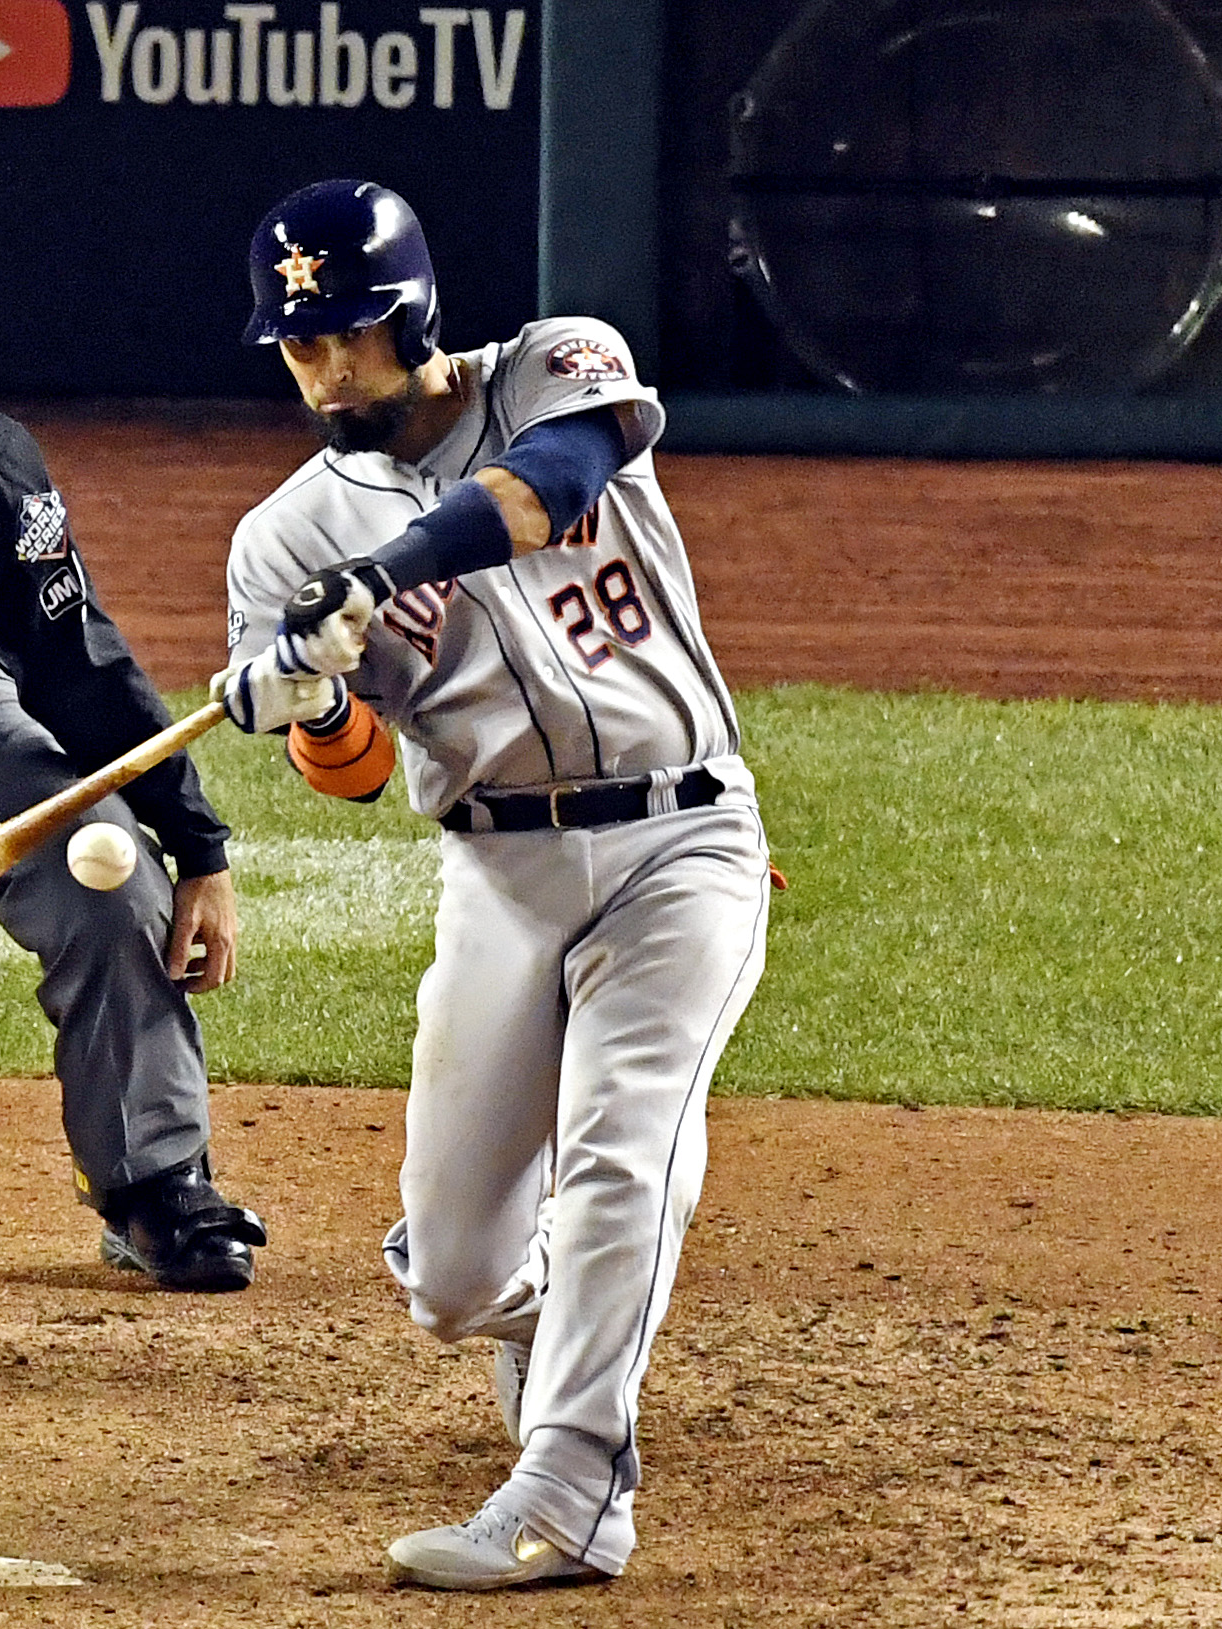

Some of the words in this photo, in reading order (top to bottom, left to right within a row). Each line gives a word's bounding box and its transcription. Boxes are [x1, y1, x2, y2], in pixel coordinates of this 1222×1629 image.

[15, 490, 60, 554] WORLD
[26, 504, 66, 563] SERIES
[47, 574, 79, 611] JM
[546, 558, 651, 674] 28
